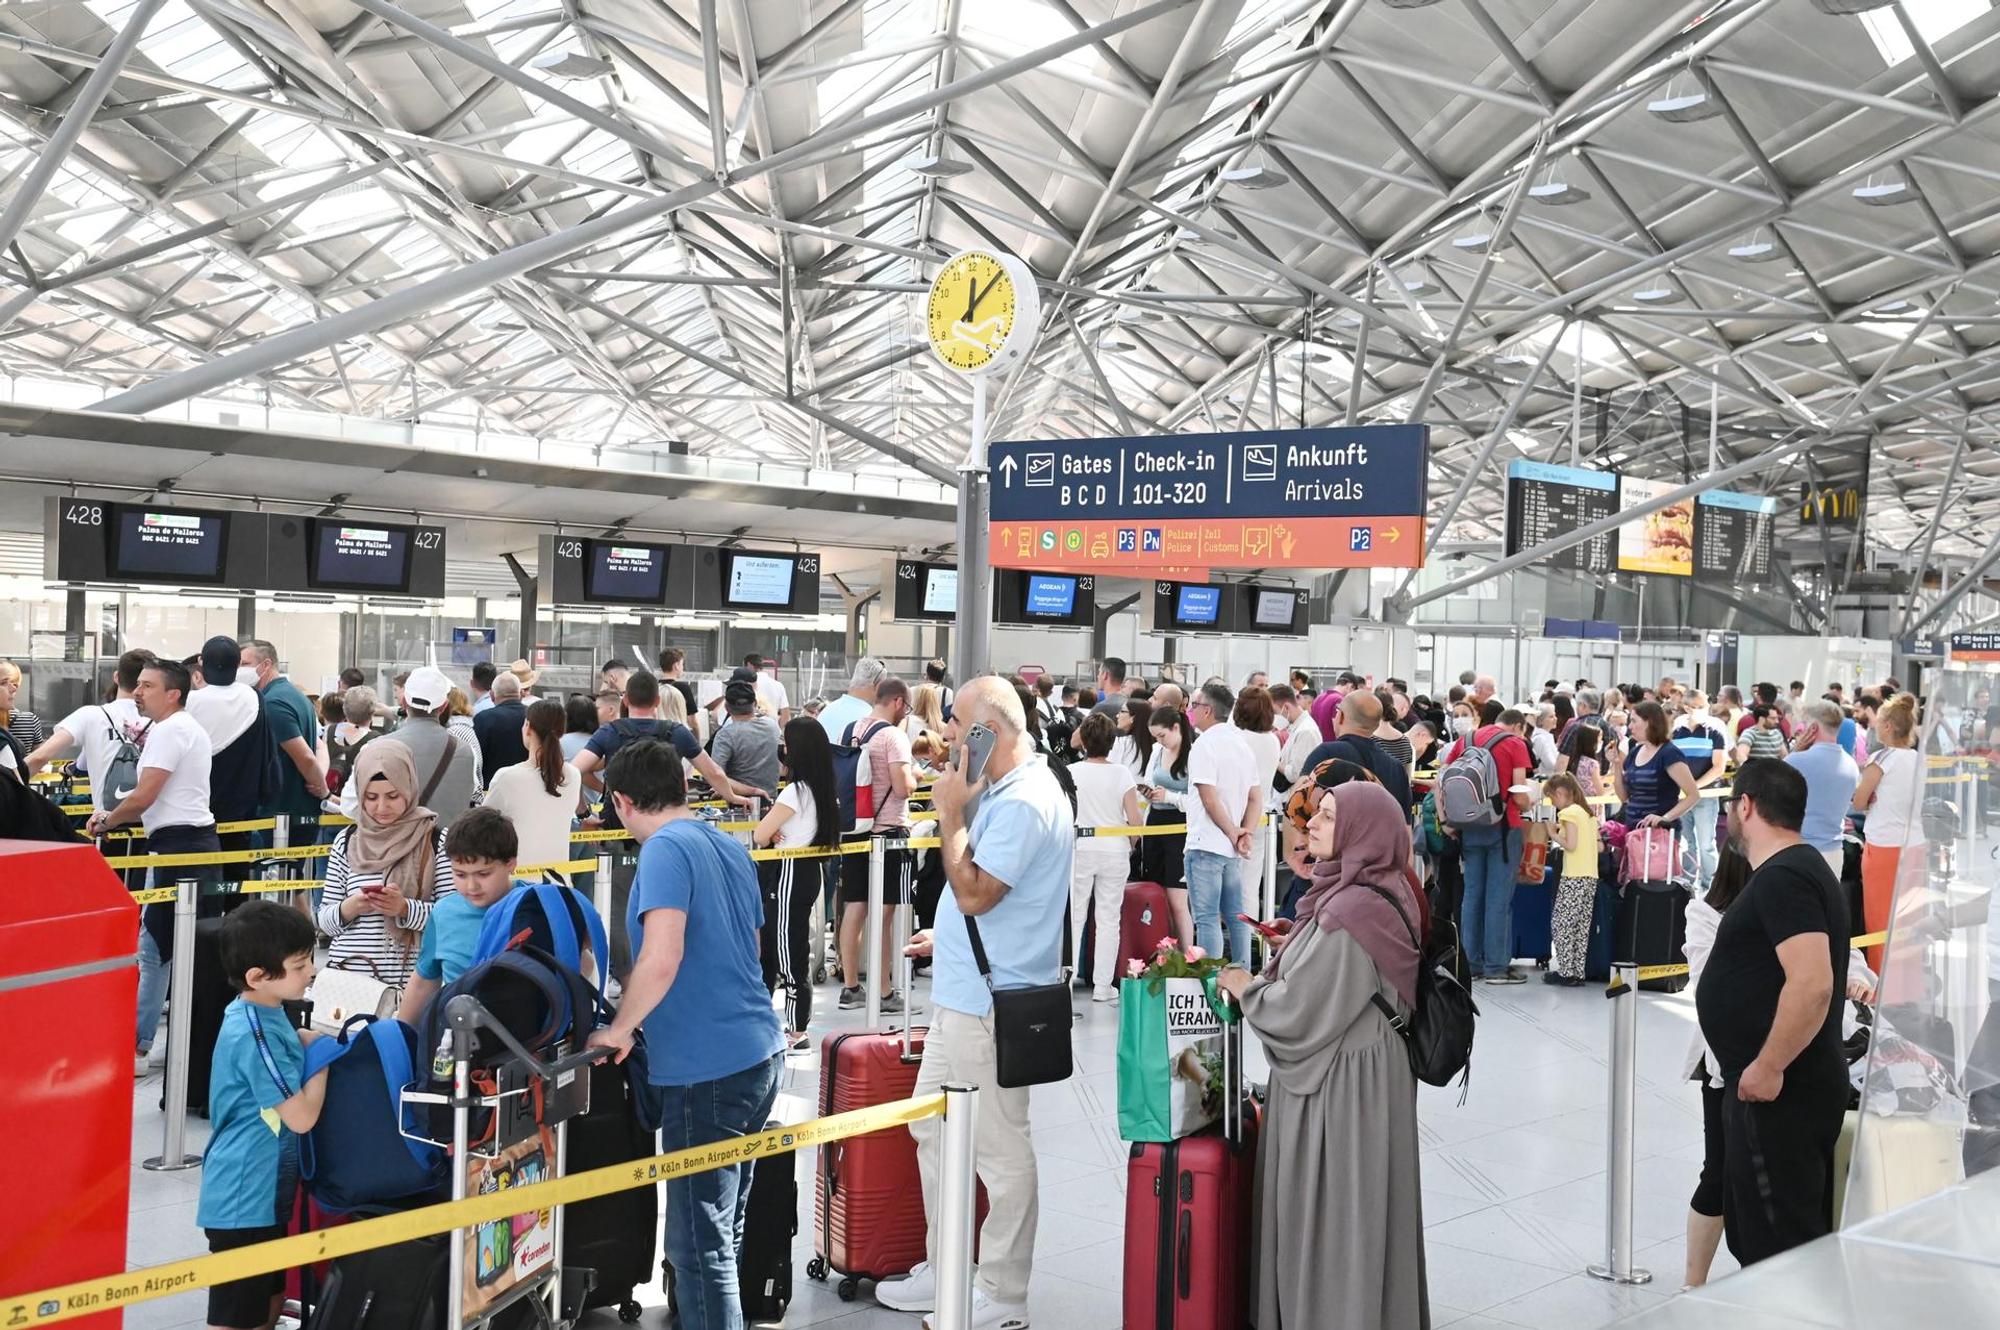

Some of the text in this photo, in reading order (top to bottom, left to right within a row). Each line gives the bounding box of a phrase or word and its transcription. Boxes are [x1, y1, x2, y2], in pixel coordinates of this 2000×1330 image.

[1134, 450, 1214, 472] Check-in
[1287, 443, 1368, 467] Ankunft
[1062, 454, 1112, 474] Gates
[1061, 485, 1106, 505] B C D
[1132, 483, 1207, 505] 101-320
[1285, 478, 1363, 501] Arrivals
[66, 505, 102, 525] 428
[138, 525, 161, 534] Palma
[173, 528, 204, 536] Mallorca
[1168, 530, 1197, 539] Polizei
[1204, 529, 1221, 538] Zoll
[415, 532, 441, 549] 427
[1042, 532, 1055, 549] S
[1168, 543, 1192, 552] Police
[1204, 542, 1239, 552] Customs
[558, 542, 582, 558] 426
[797, 559, 817, 573] 425
[899, 565, 916, 579] 424
[1157, 583, 1171, 595] 422
[1169, 995, 1194, 1009] ICH
[796, 1118, 867, 1142] Köln Bonn Airport
[661, 1148, 740, 1175] Köln Bonn Airport
[527, 1242, 550, 1263] corendon
[67, 1271, 196, 1310] Köln Bonn Airport
